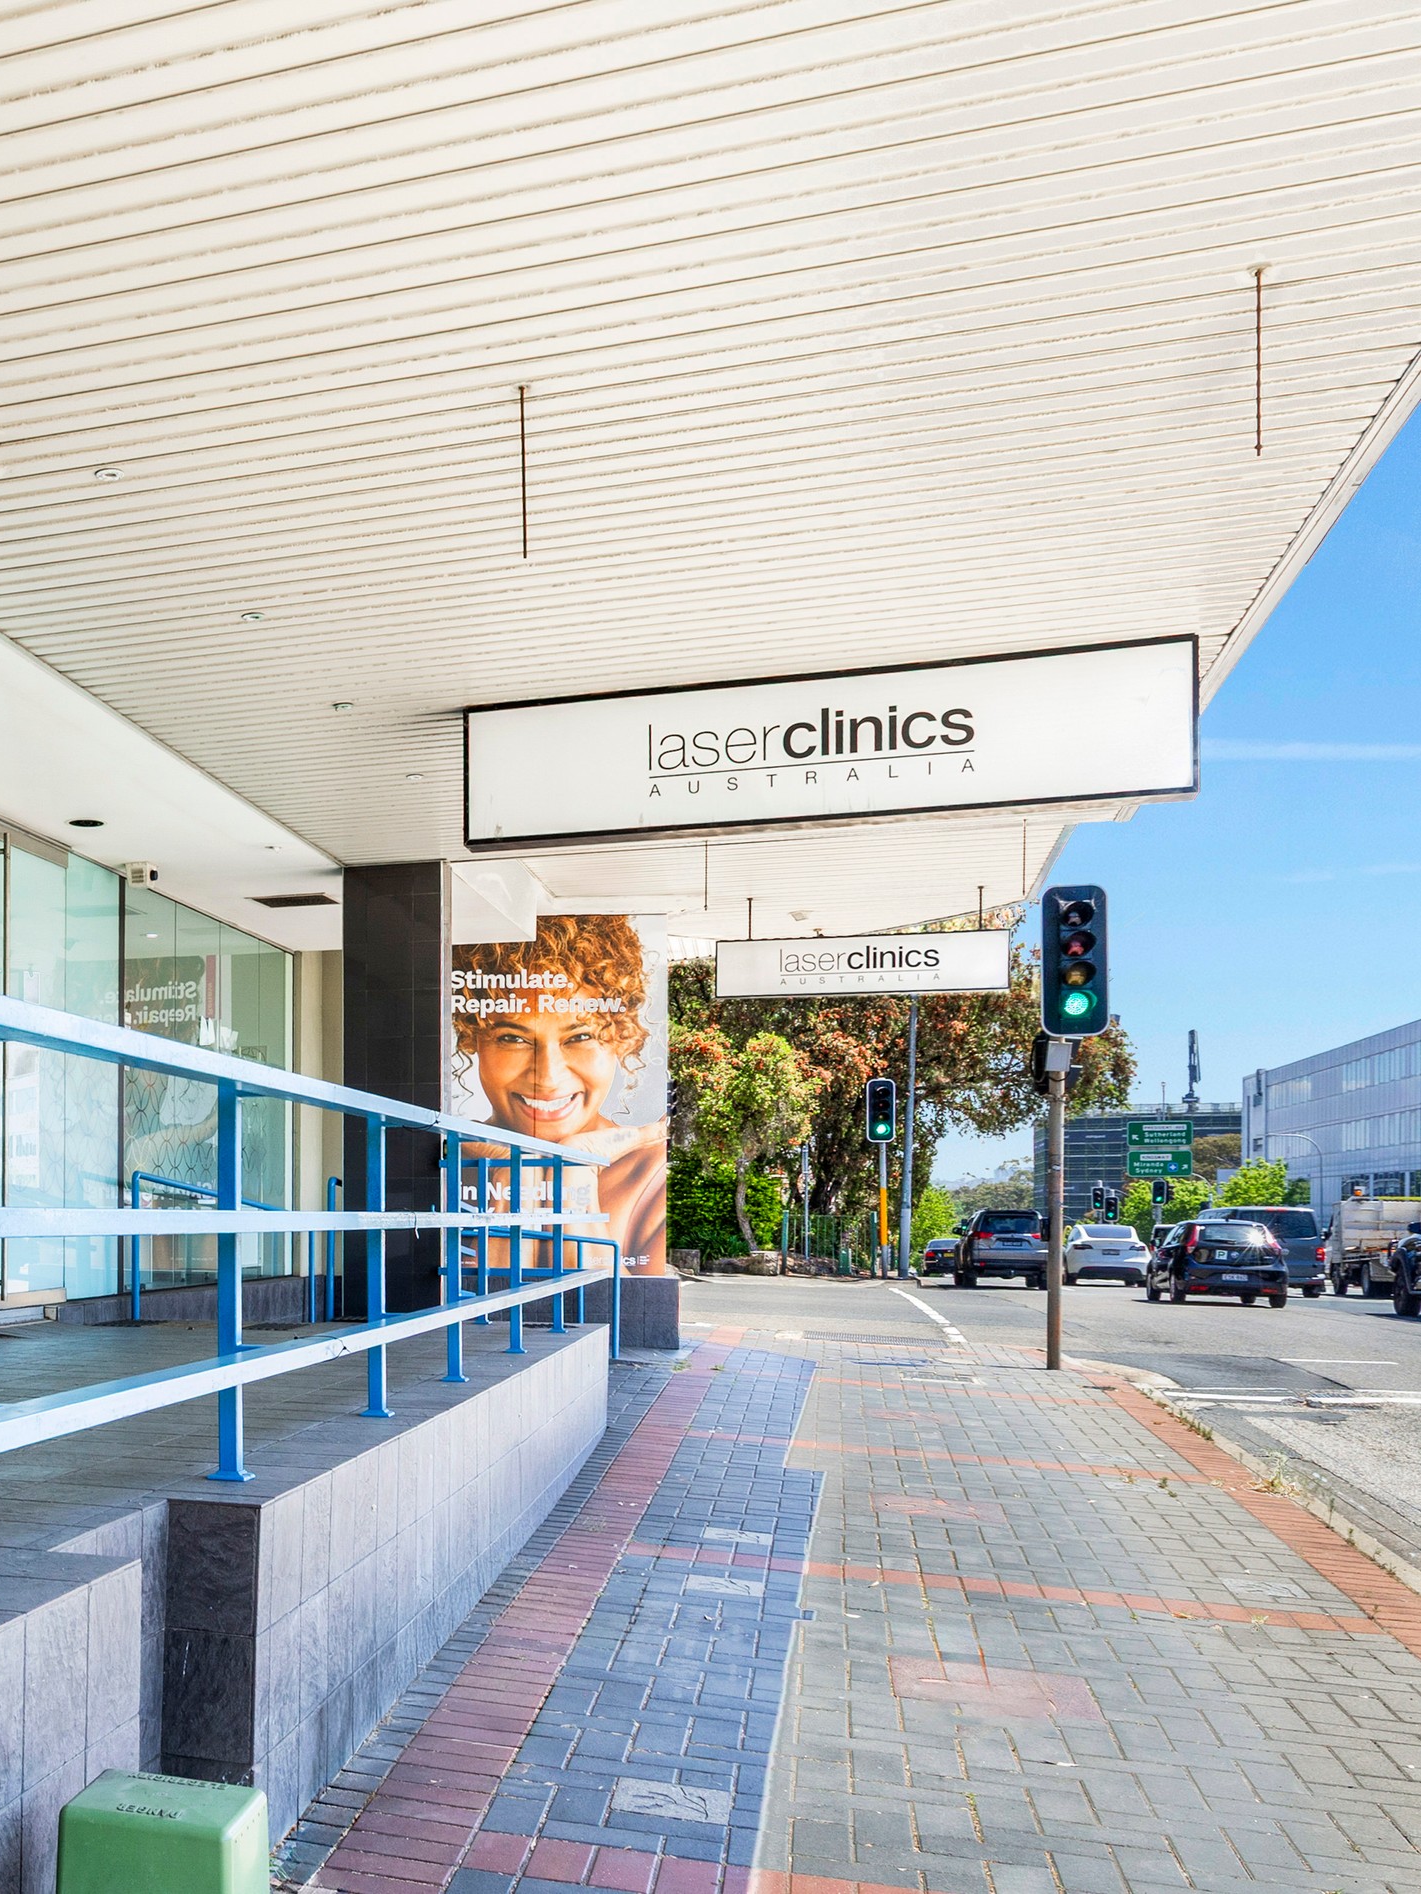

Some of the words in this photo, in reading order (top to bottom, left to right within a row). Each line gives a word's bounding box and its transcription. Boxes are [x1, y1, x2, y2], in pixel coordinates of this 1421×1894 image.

[648, 705, 976, 772] laserclinics
[648, 757, 976, 798] AUSTRALIA
[778, 945, 941, 974] laserclinics
[451, 968, 574, 990] Stimulate.
[779, 972, 941, 985] AUSTRALIA
[451, 993, 531, 1019] Repair.
[538, 994, 626, 1013] Renew.
[116, 1802, 185, 1820] DANGER
